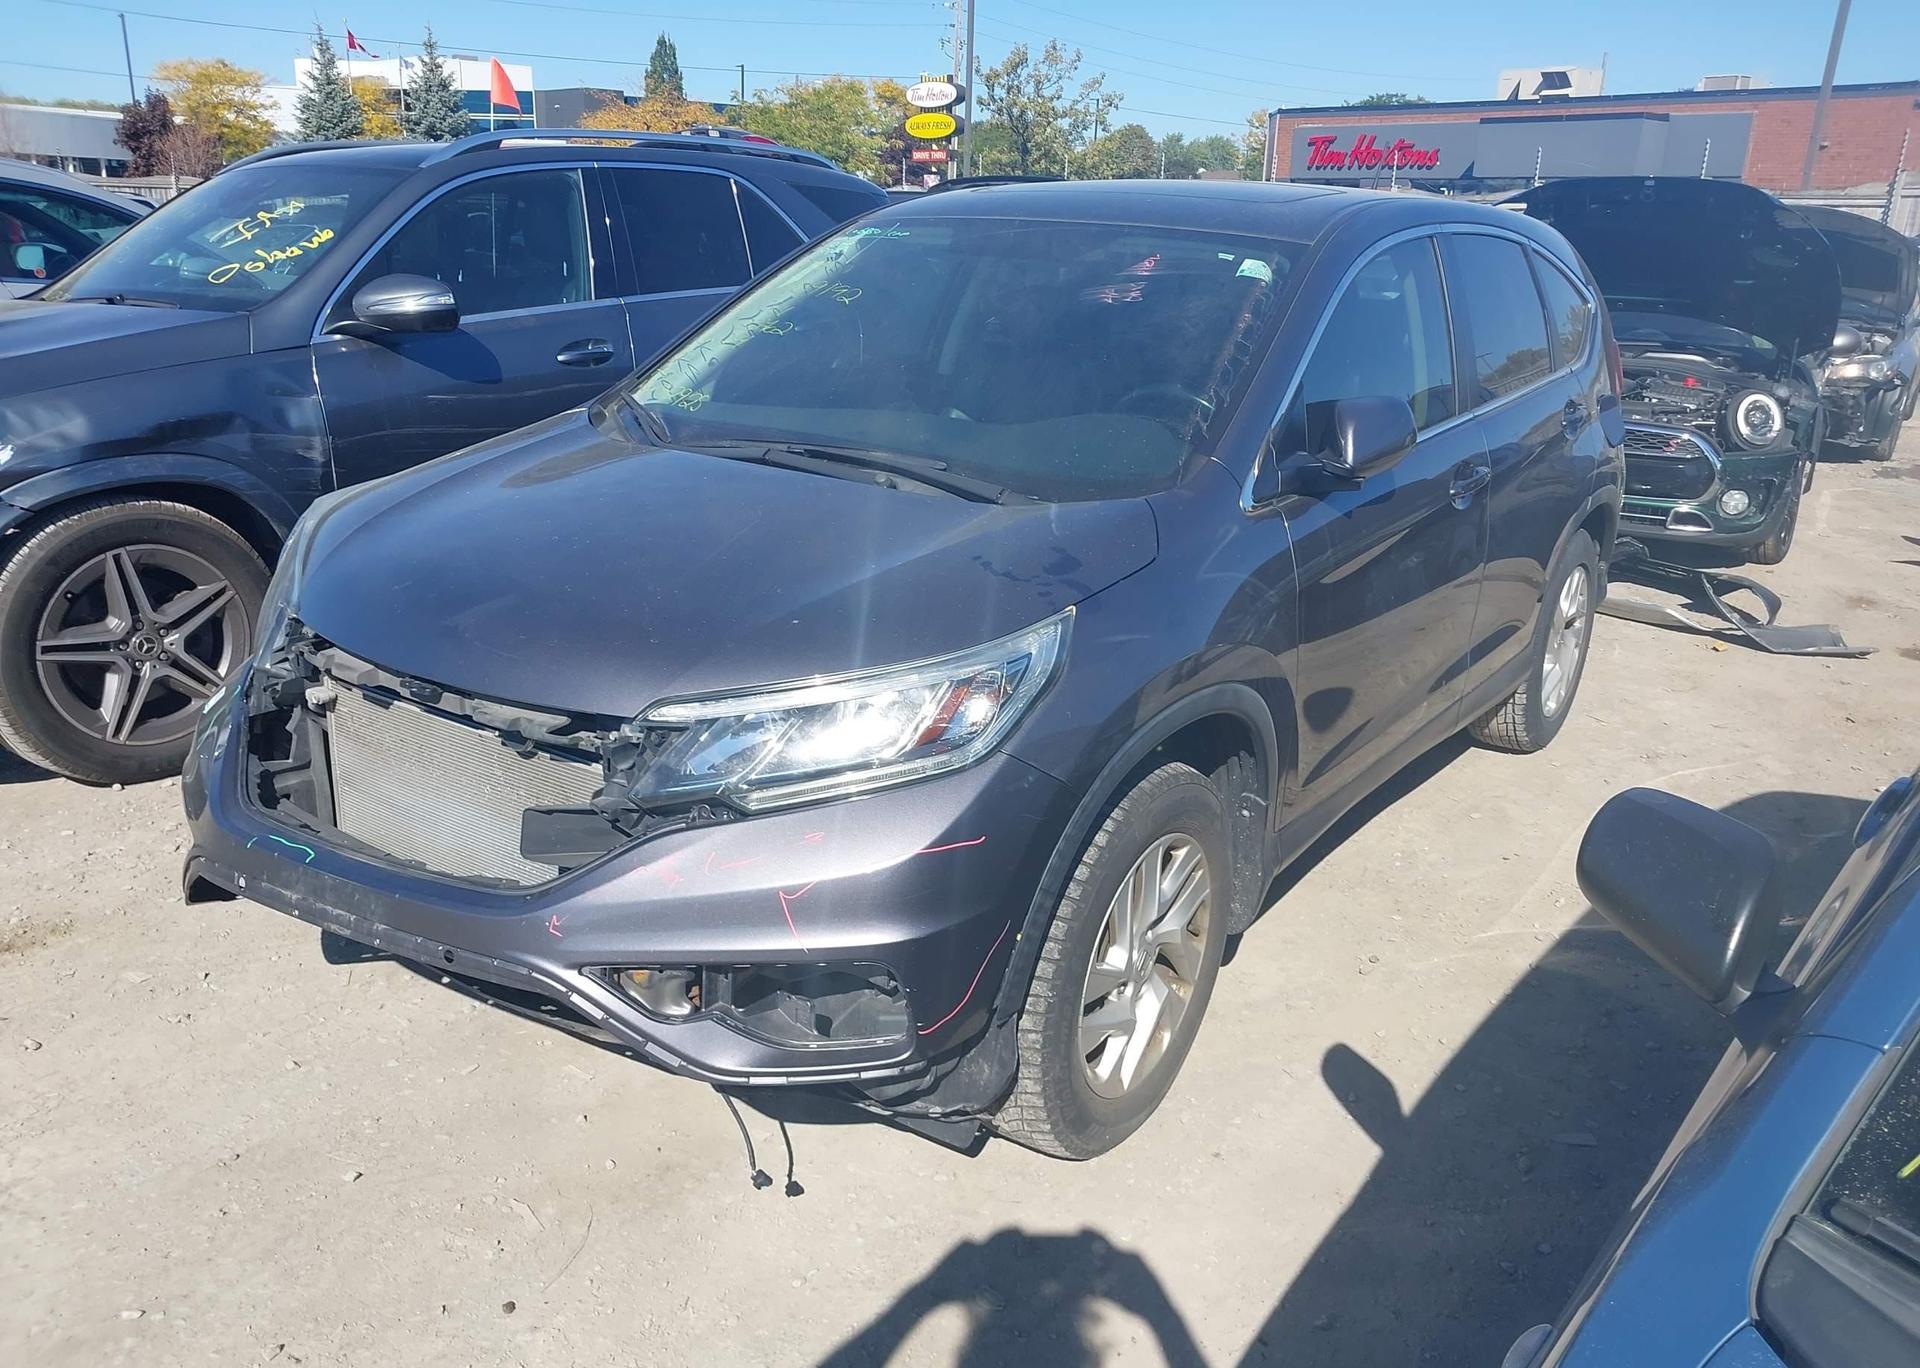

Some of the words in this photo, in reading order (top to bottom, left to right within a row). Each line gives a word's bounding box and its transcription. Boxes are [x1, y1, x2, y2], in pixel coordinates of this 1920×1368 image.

[932, 120, 952, 130] FRESH
[912, 150, 930, 160] DRIVE
[930, 150, 947, 160] THRU
[1307, 135, 1348, 170] Tim
